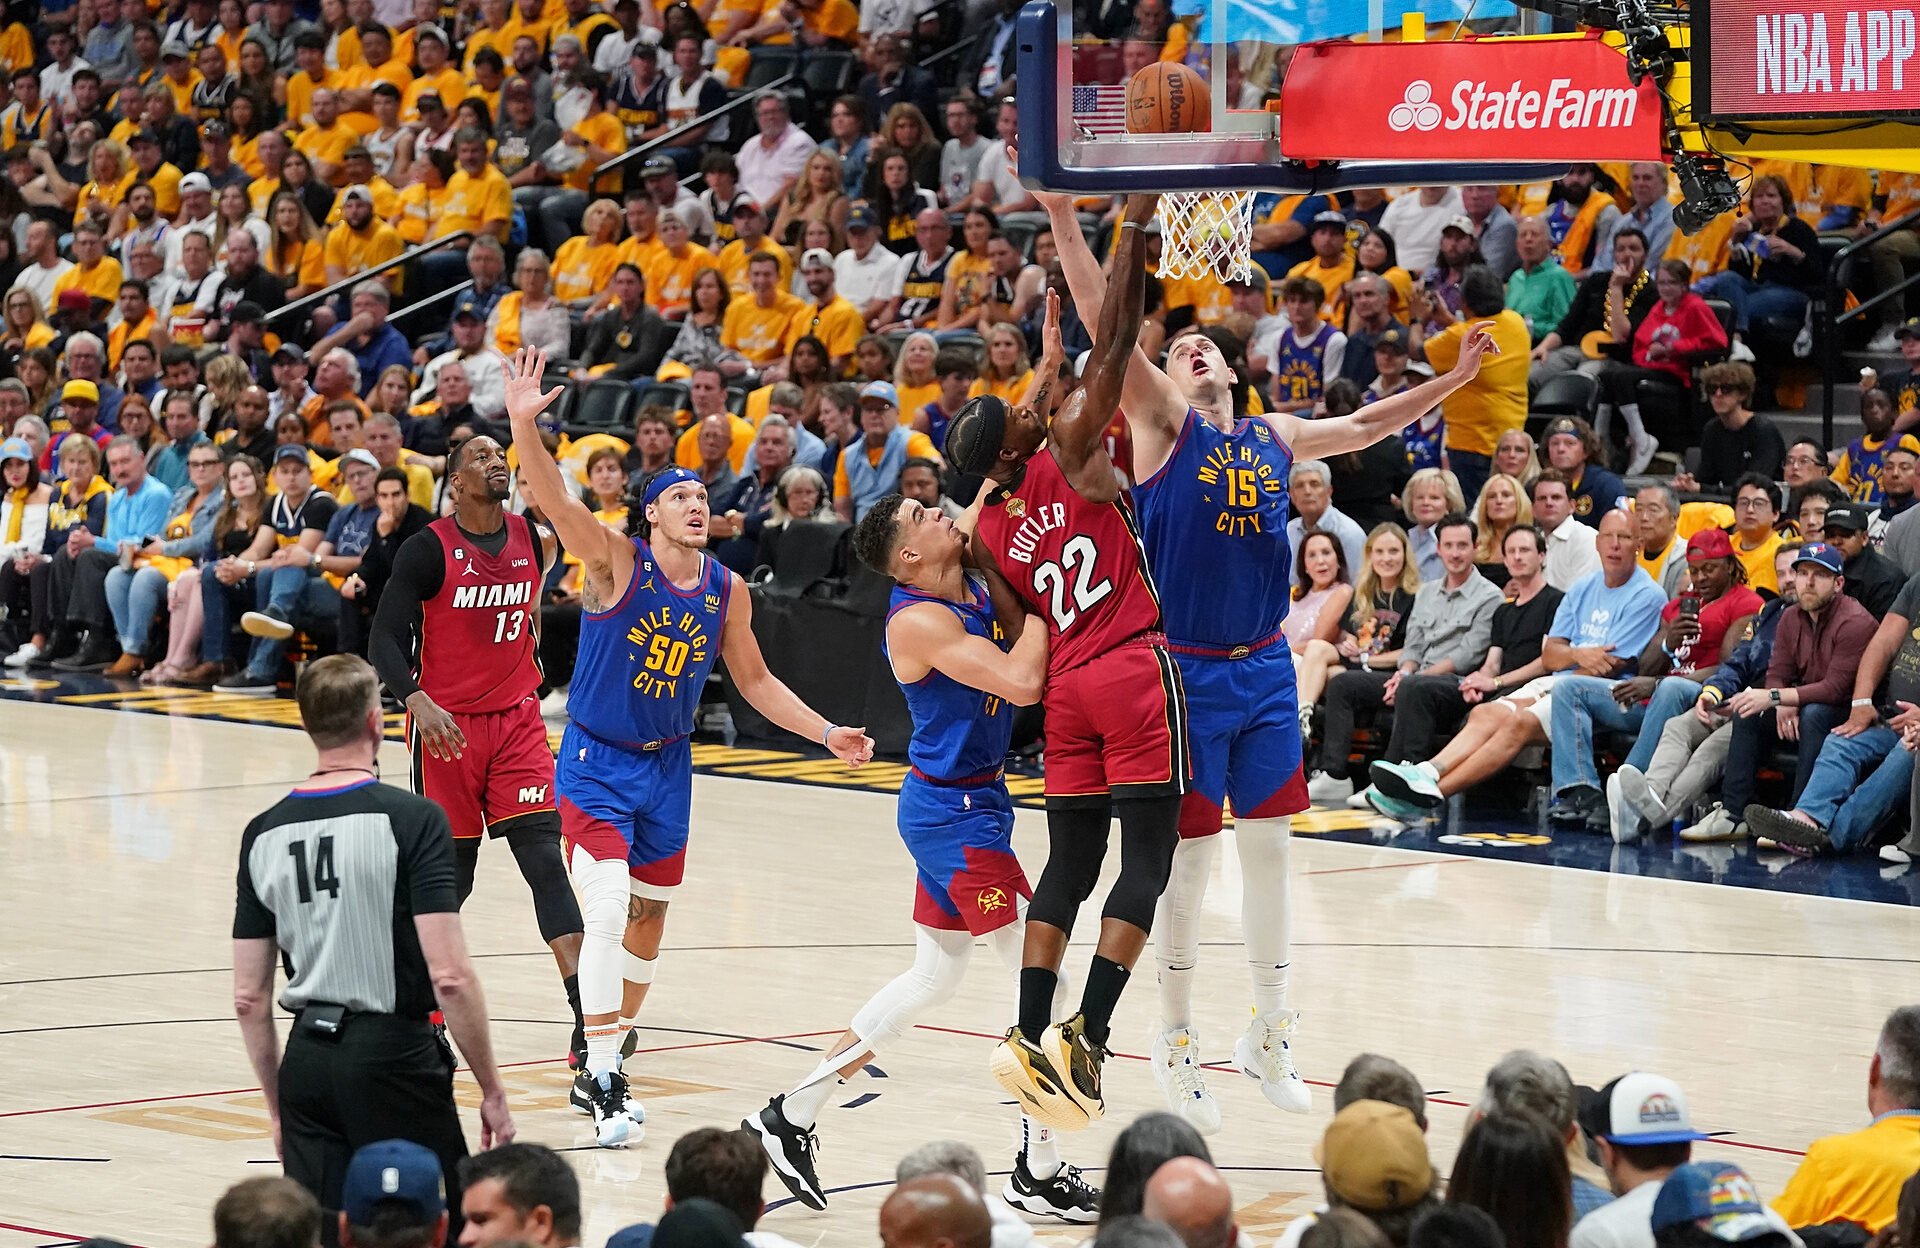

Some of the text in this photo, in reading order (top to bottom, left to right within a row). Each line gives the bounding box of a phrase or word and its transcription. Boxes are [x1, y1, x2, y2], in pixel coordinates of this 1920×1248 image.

[1757, 10, 1916, 94] NBA APP
[1167, 73, 1185, 132] Wilson
[1198, 442, 1280, 492] MILE HIGH
[1226, 468, 1257, 507] 15
[1008, 502, 1066, 564] BUTLER
[1216, 511, 1261, 537] CITY
[511, 558, 529, 568] UKG
[1033, 533, 1115, 634] 22
[452, 580, 532, 609] MIAMI
[705, 593, 720, 606] WU
[494, 609, 525, 644] 13
[626, 606, 708, 662] MILE HIGH
[644, 633, 690, 677] 50
[633, 671, 677, 699] CITY
[288, 835, 340, 904] 14
